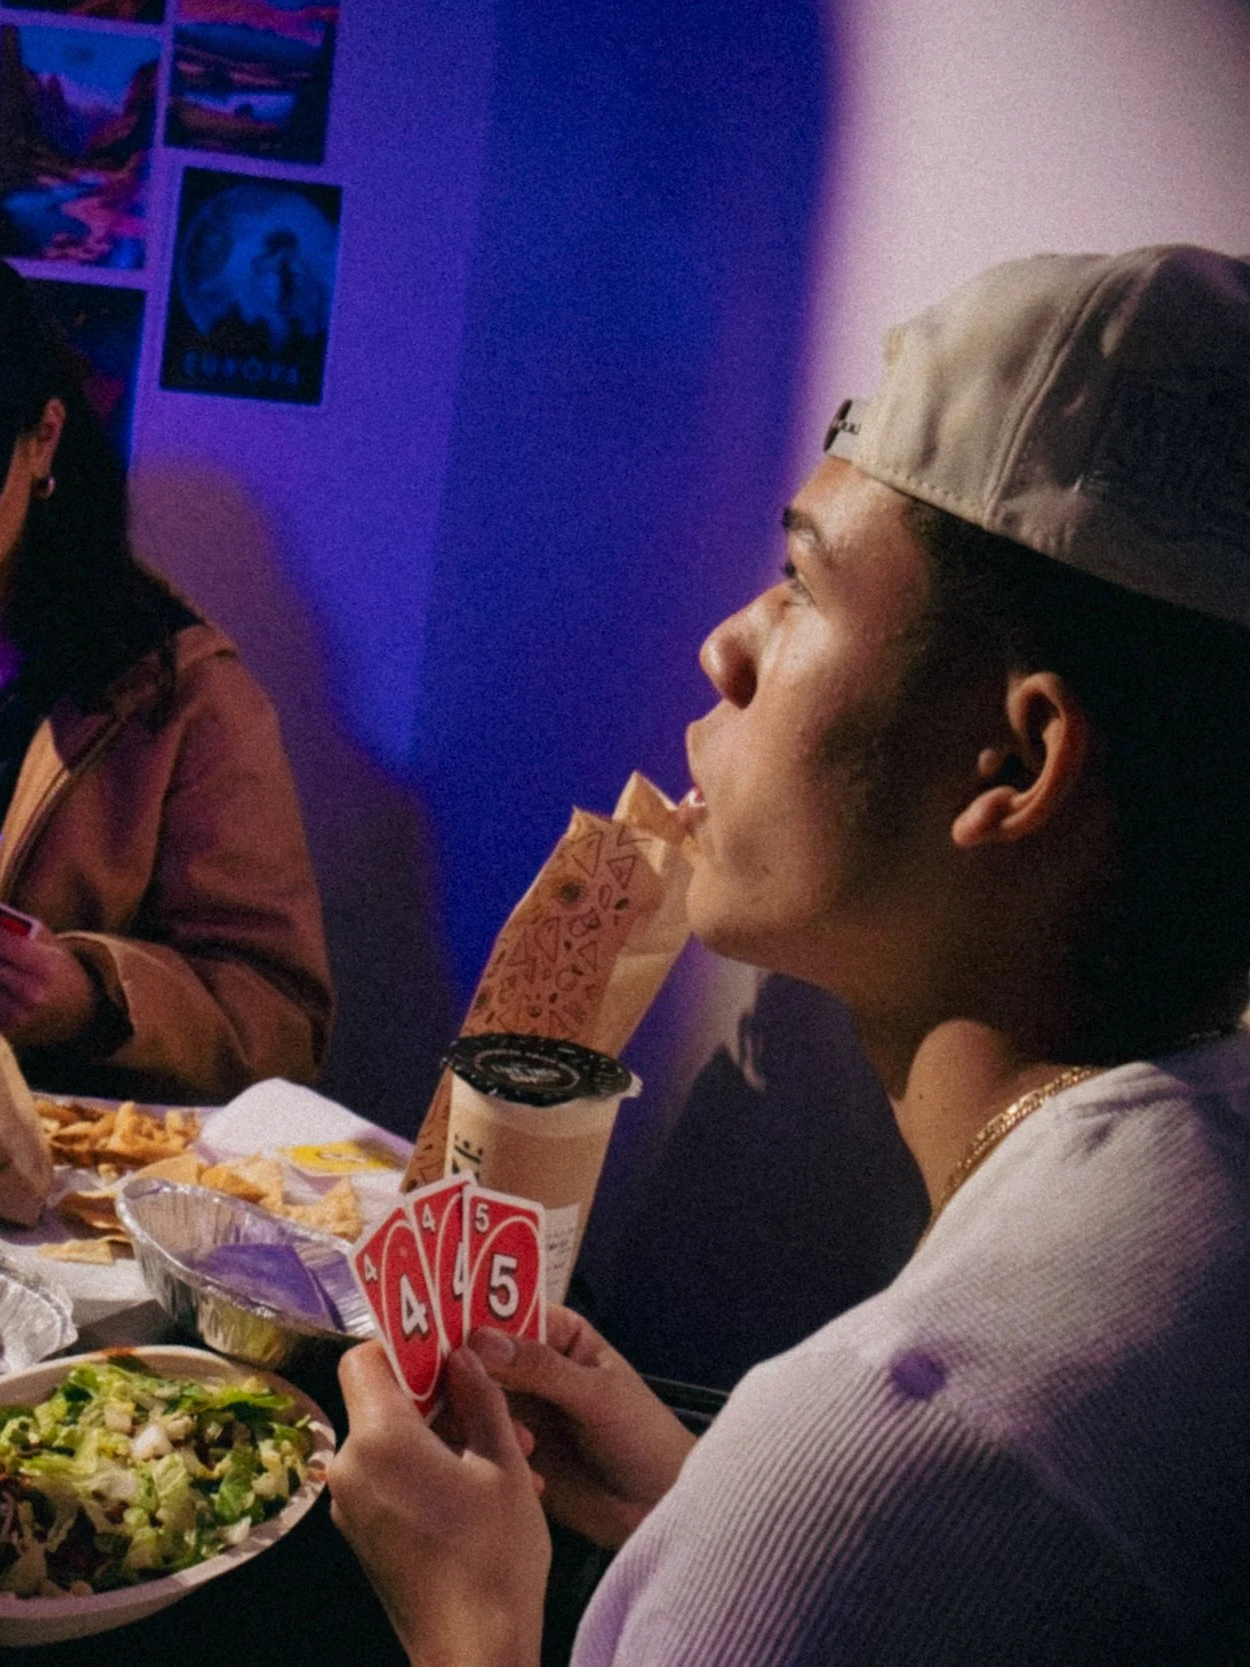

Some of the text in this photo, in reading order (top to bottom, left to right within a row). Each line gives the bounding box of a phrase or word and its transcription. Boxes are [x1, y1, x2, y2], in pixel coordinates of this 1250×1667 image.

[422, 1203, 436, 1233] 4
[475, 1204, 490, 1233] 5
[363, 1252, 378, 1283] 4
[488, 1254, 519, 1318] 5
[400, 1275, 429, 1337] 4
